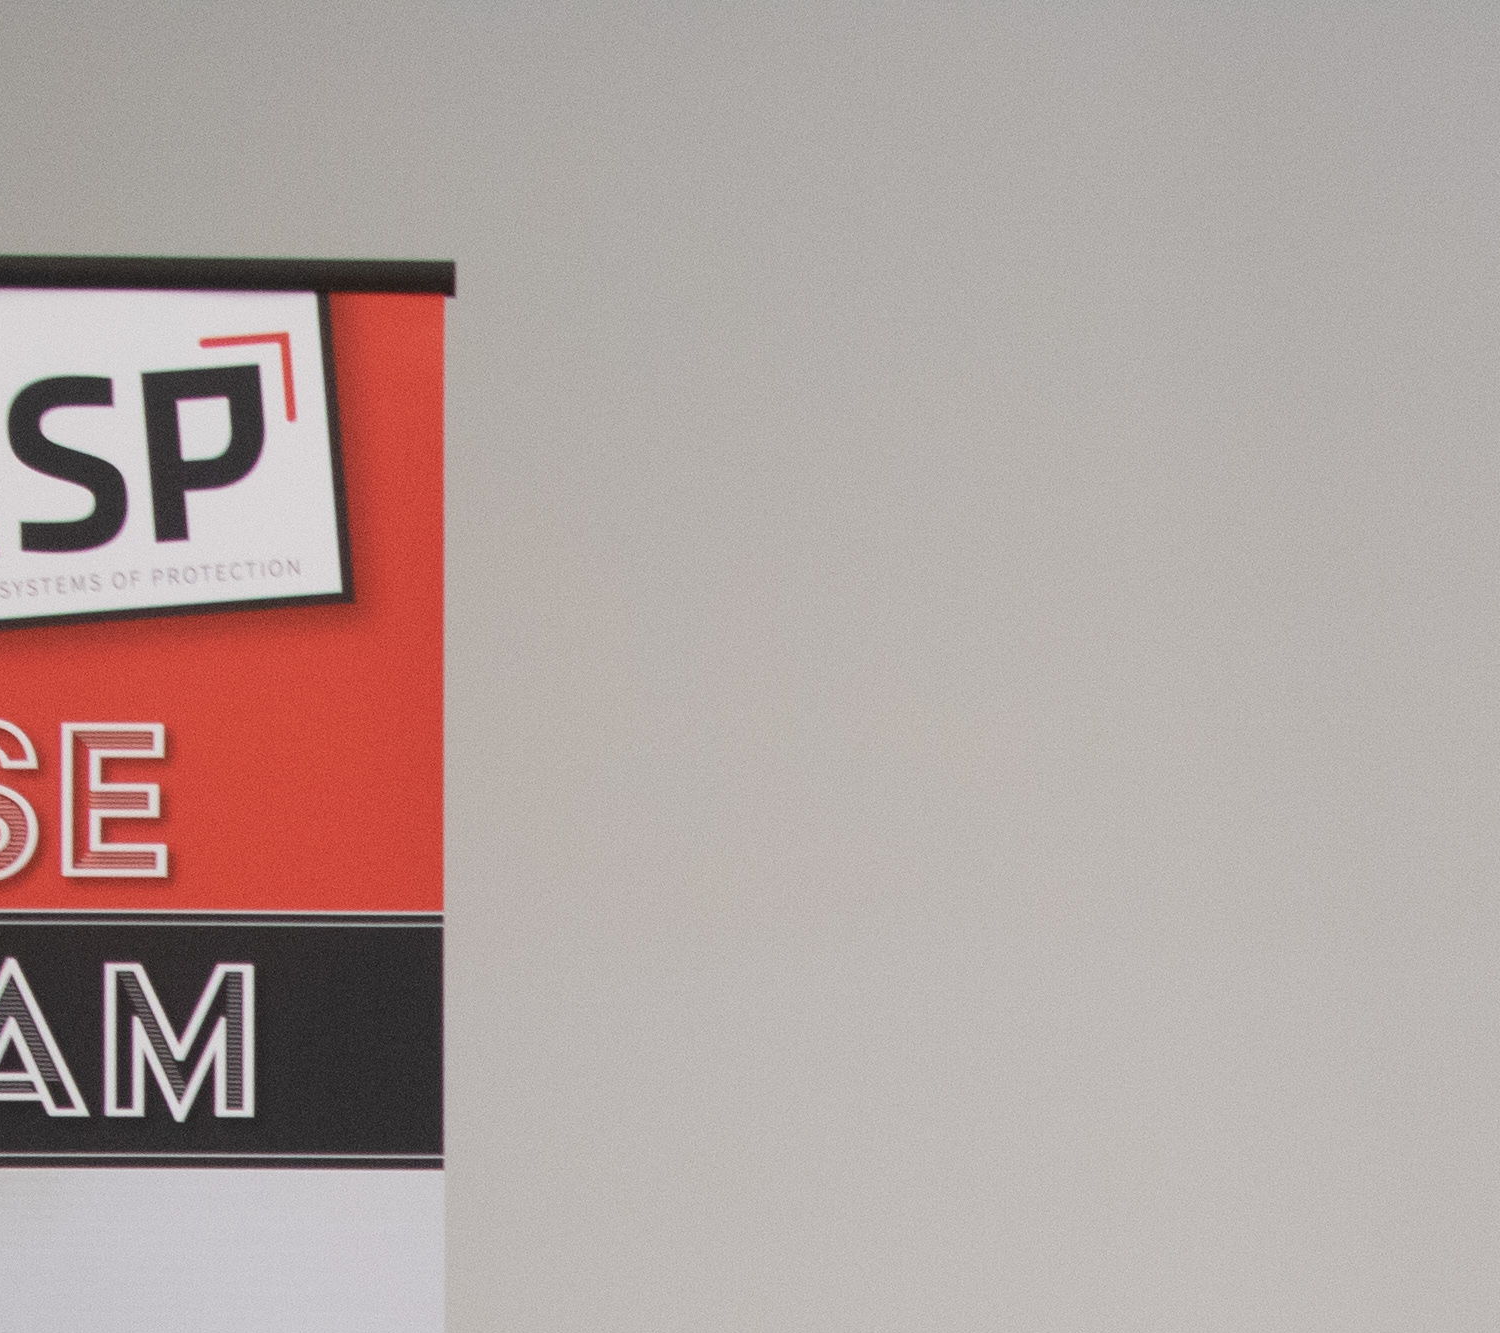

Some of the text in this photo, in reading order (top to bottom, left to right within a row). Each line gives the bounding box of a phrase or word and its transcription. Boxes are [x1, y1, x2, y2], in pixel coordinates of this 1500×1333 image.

[0, 574, 102, 599] SYSTEMS
[112, 570, 142, 591] OF
[152, 559, 302, 587] PROTECTION
